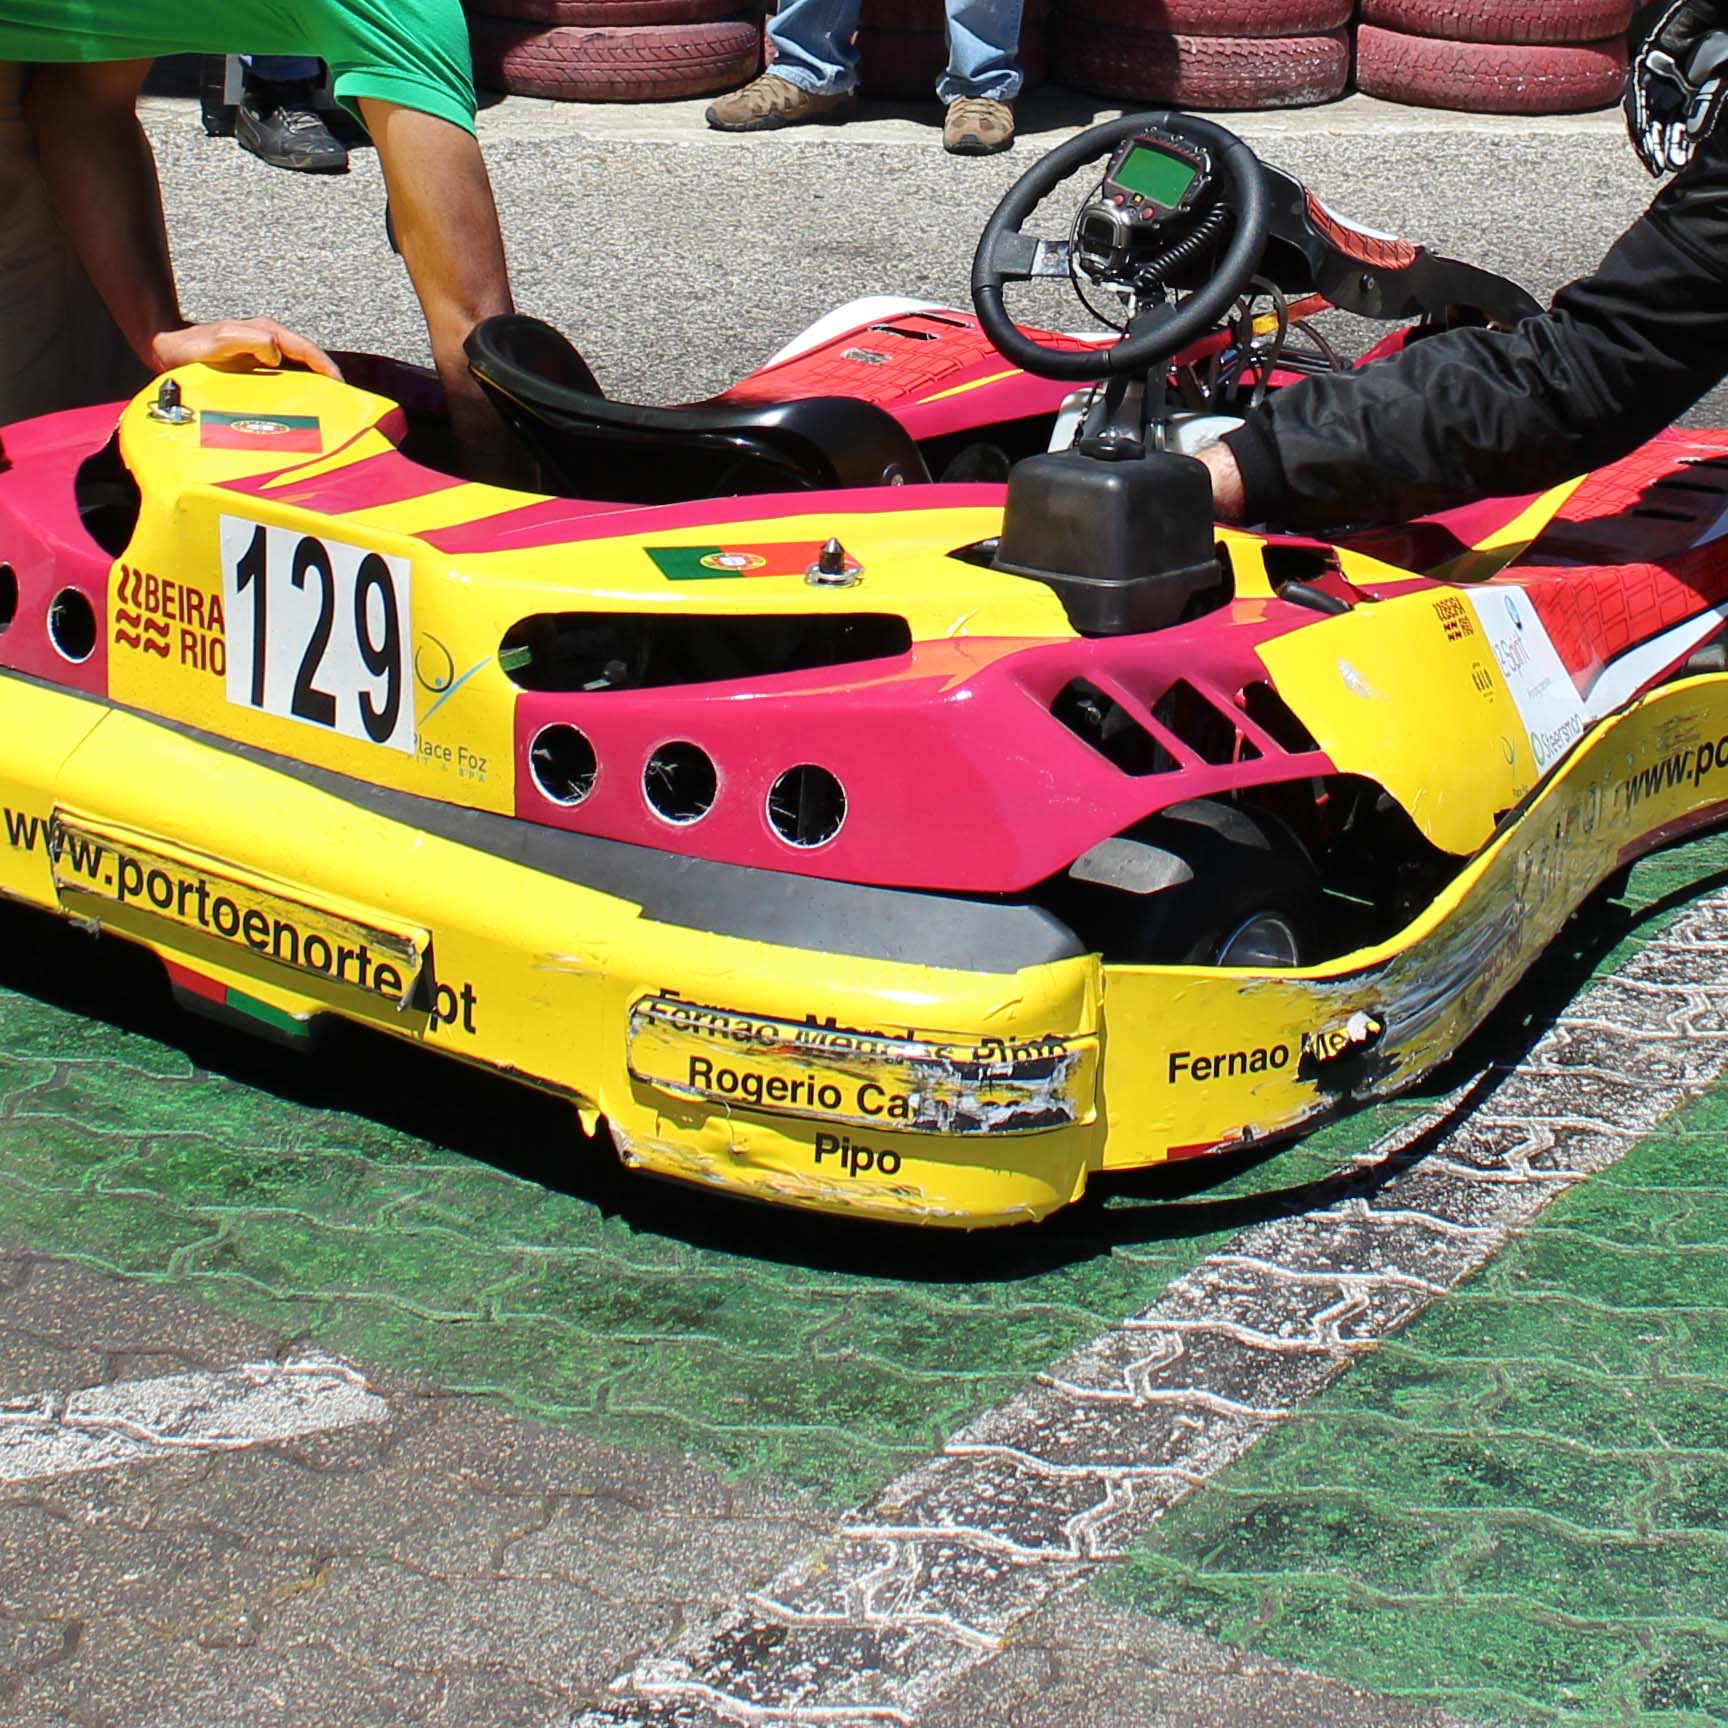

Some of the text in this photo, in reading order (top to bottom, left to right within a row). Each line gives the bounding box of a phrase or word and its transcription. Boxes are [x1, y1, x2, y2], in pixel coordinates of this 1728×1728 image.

[143, 577, 226, 634] BEIRA
[180, 629, 226, 677] RIO
[235, 522, 402, 744] 129
[457, 746, 488, 774] Foz
[3, 807, 477, 1035] www.portoenortept
[688, 1055, 843, 1108] Rogerio
[1168, 1043, 1290, 1085] Fernao
[813, 1131, 903, 1178] Pipo
